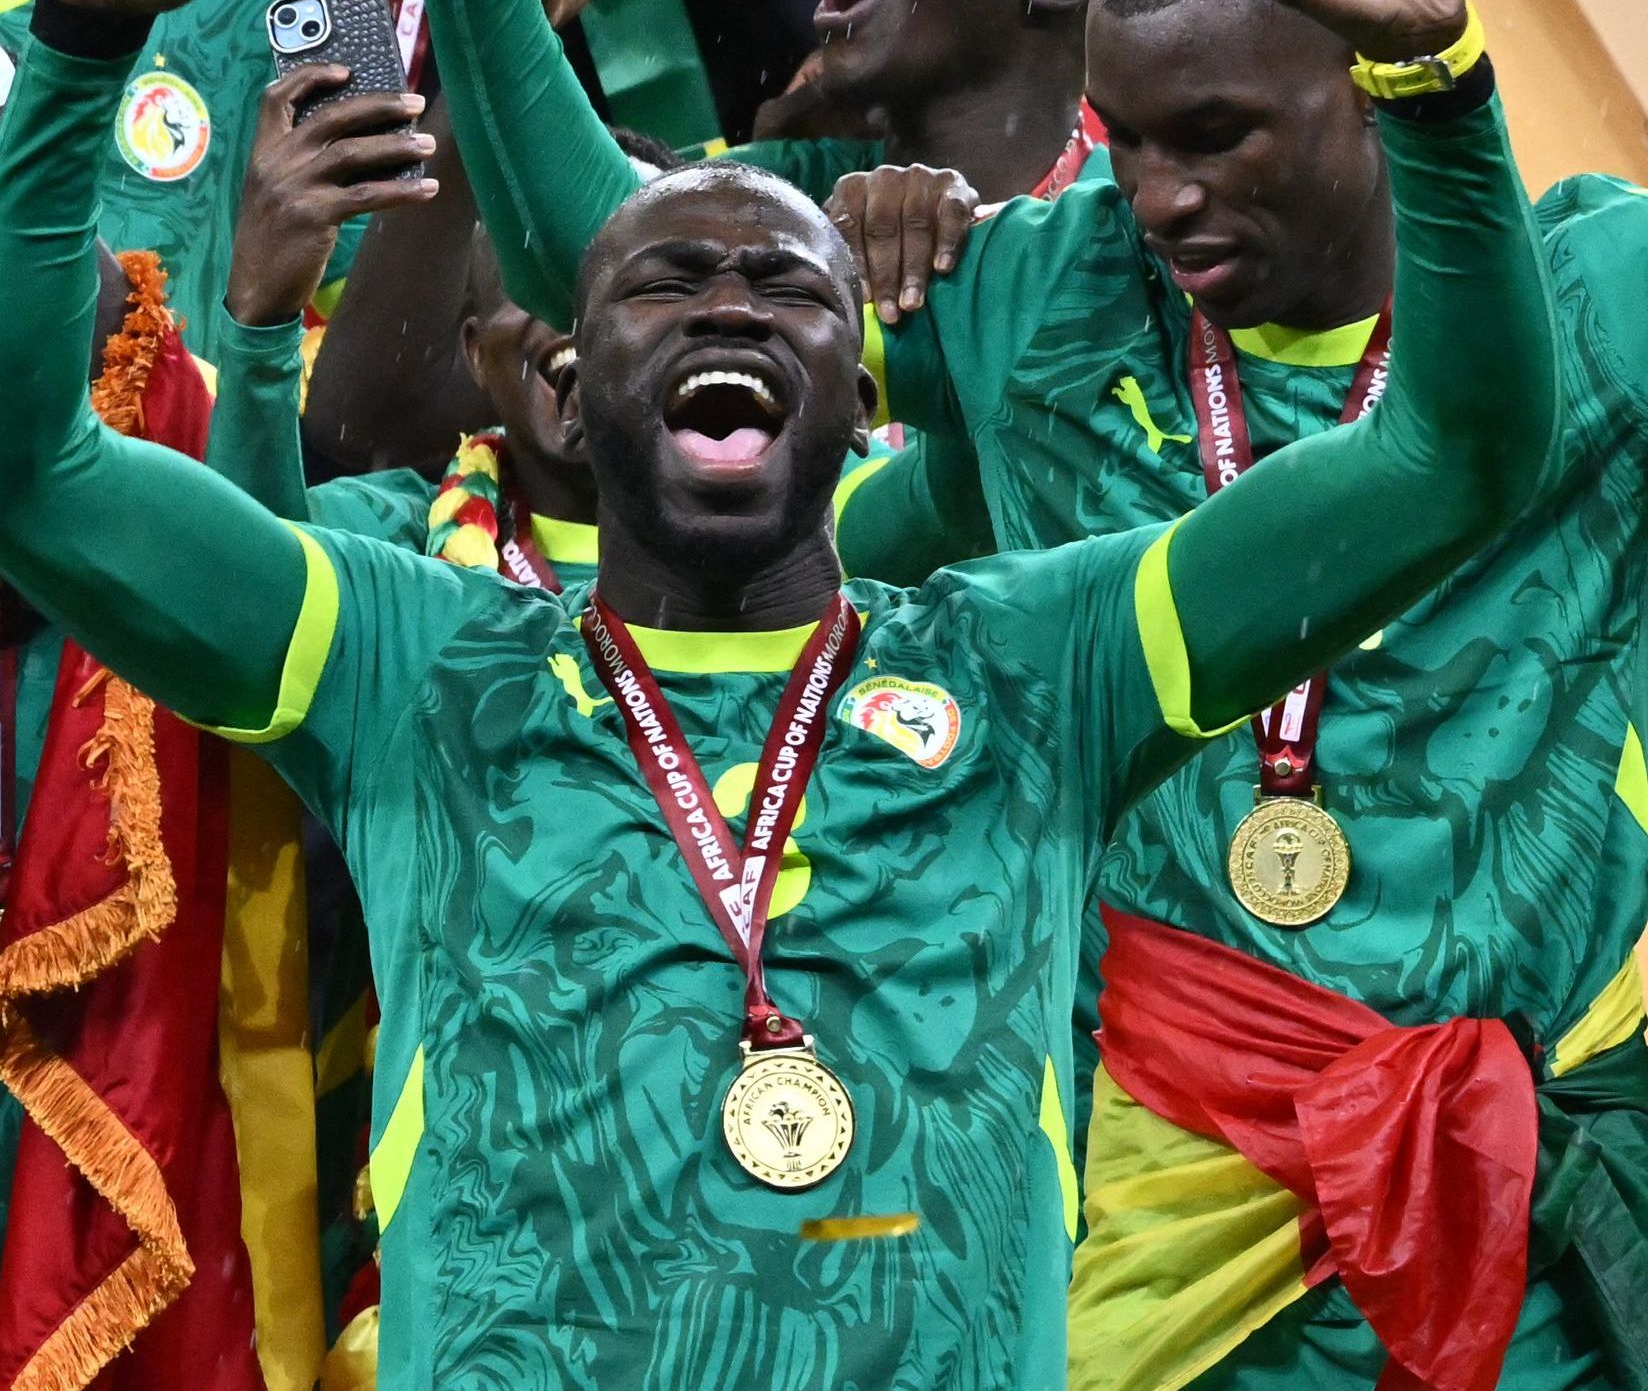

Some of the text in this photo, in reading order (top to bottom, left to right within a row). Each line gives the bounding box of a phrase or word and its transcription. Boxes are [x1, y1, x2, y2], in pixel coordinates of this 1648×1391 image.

[1205, 364, 1235, 456] NATIONS
[1218, 458, 1239, 486] OF
[615, 669, 667, 743] NATIONS
[653, 736, 680, 771] OF
[751, 783, 788, 851] AFRICA
[771, 747, 799, 784] CUP
[787, 723, 812, 748] OF
[802, 655, 834, 726] NATIONS
[667, 771, 698, 810] CUP
[687, 807, 734, 881] AFRICA
[1245, 839, 1258, 869] CAF
[1274, 819, 1308, 832] AFRICA
[743, 1076, 832, 1126] AFRICAN CHAMPION
